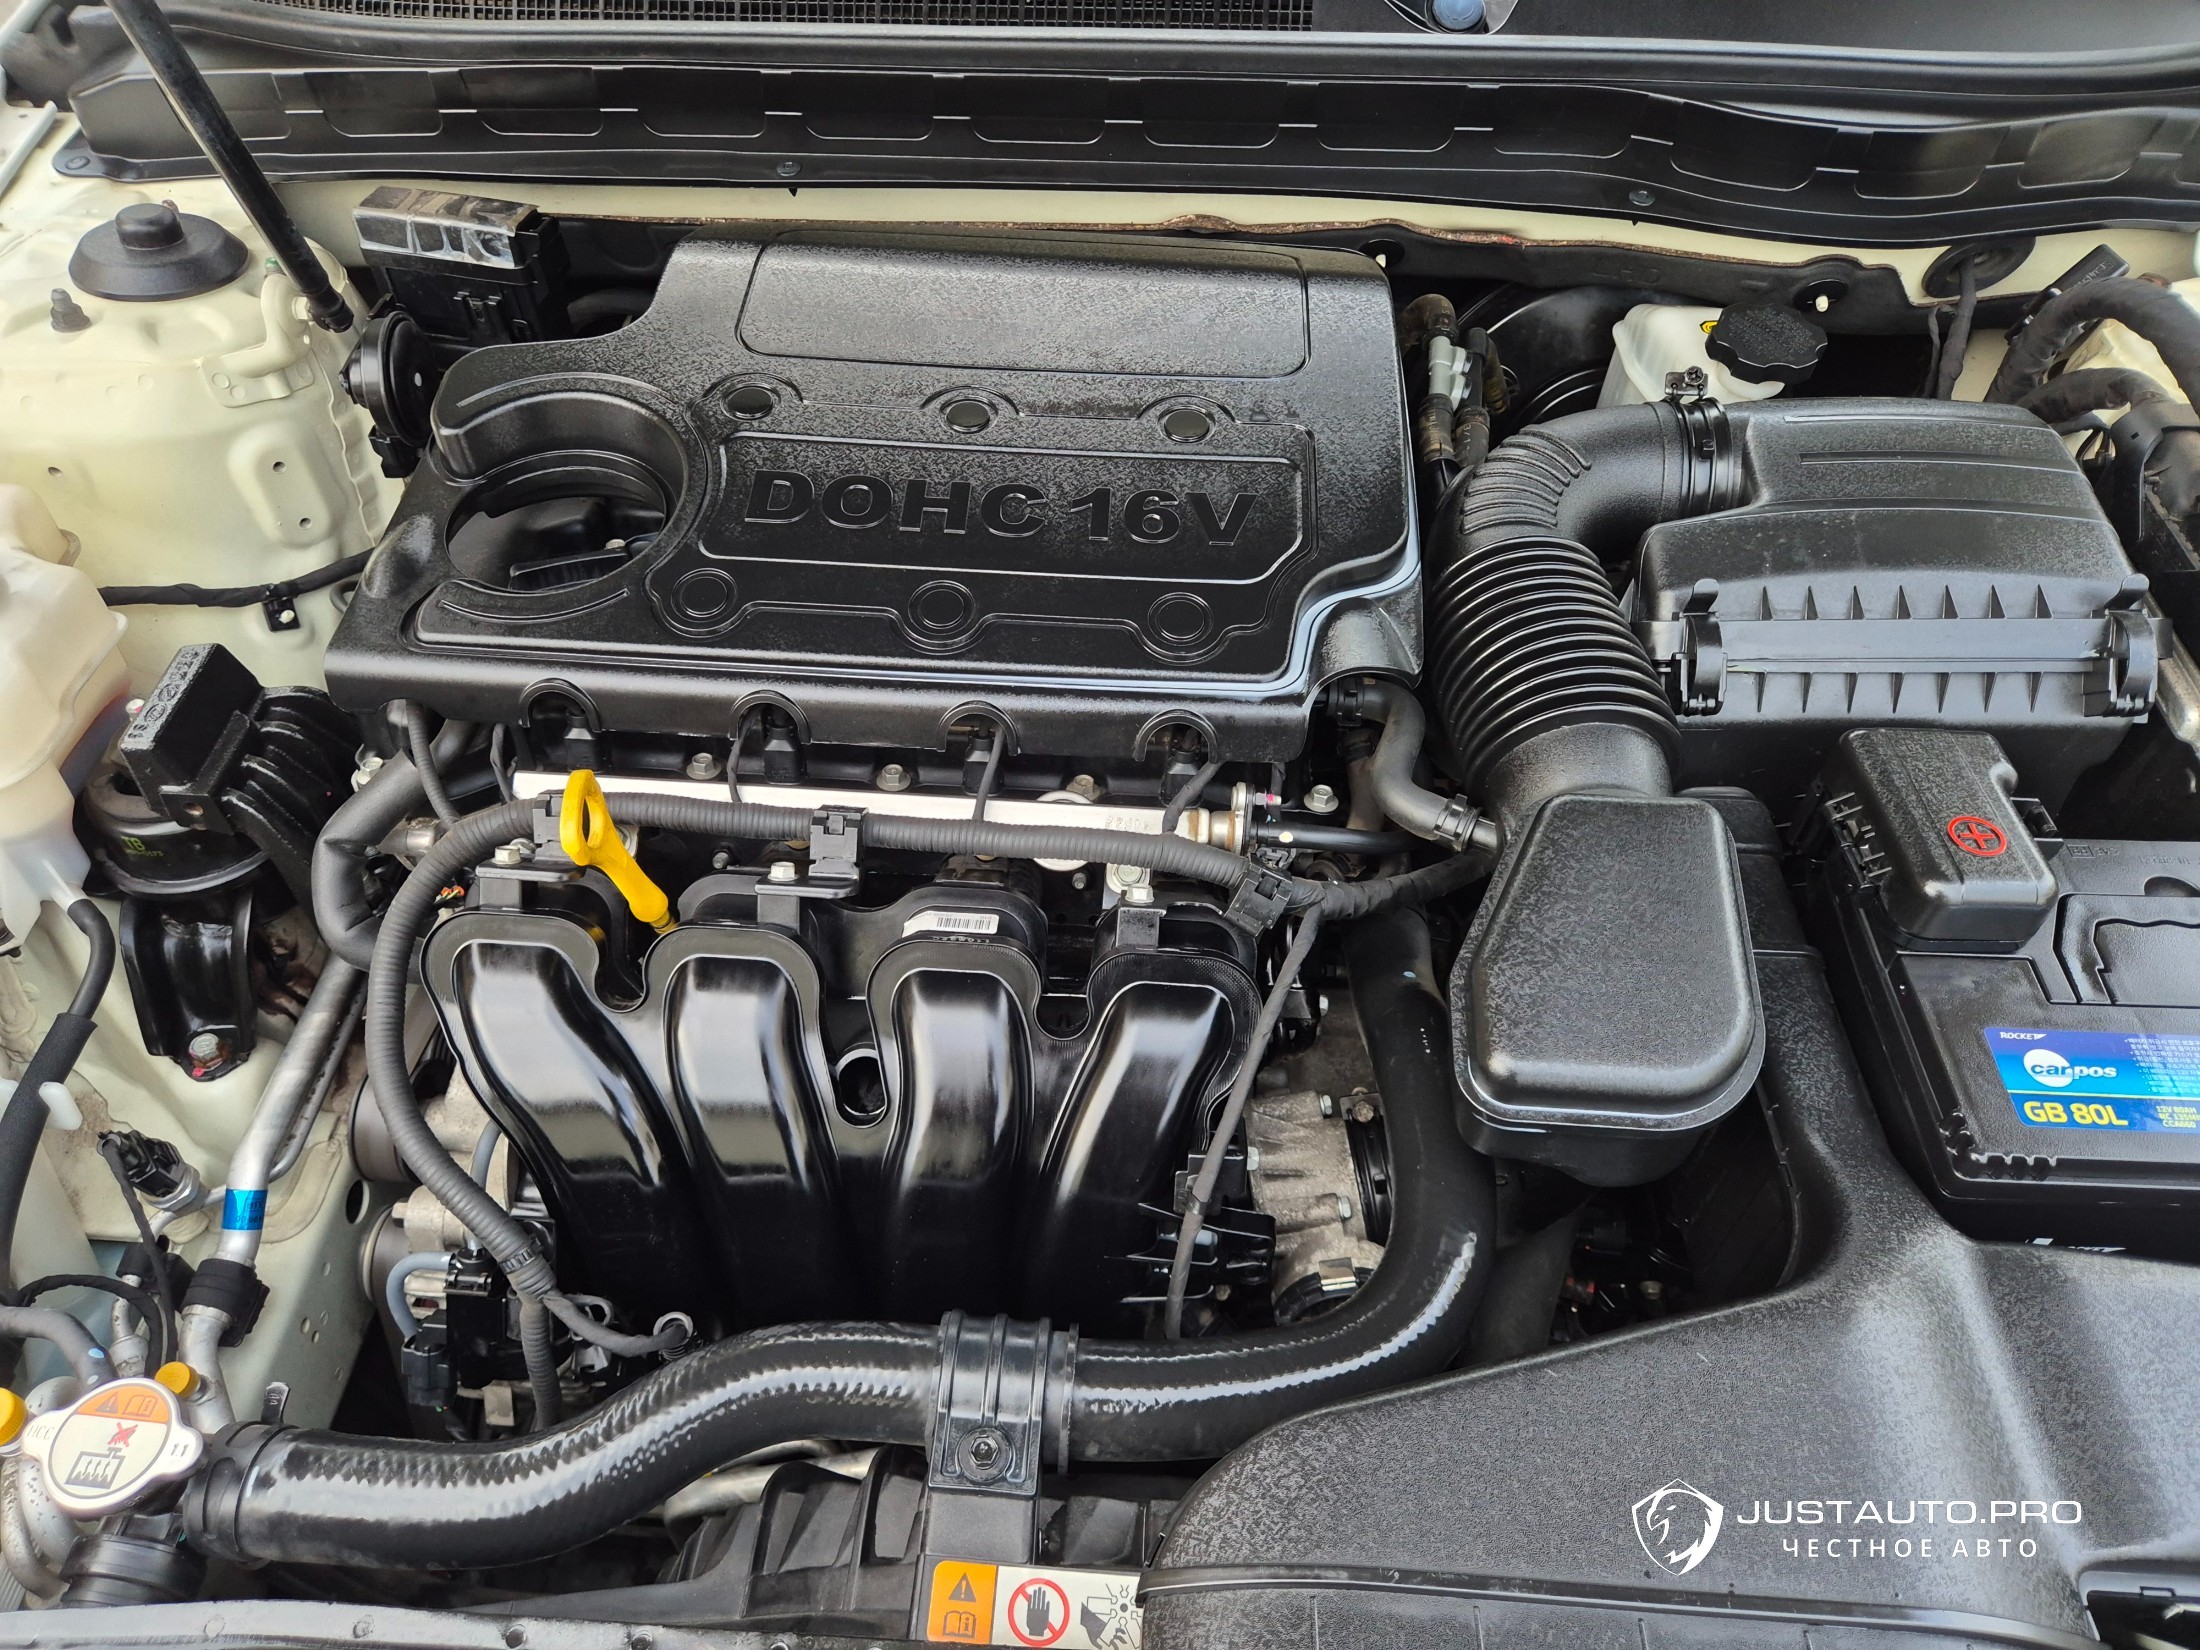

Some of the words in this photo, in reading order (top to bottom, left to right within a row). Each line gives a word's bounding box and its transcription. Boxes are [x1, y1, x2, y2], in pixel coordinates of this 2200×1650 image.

[744, 469, 1047, 537] DOHC
[1070, 487, 1259, 546] 16V
[1999, 1031, 2045, 1041] ROCKET
[2030, 1063, 2117, 1080] carpos
[2023, 1100, 2068, 1123] GB
[2069, 1102, 2129, 1126] 80L
